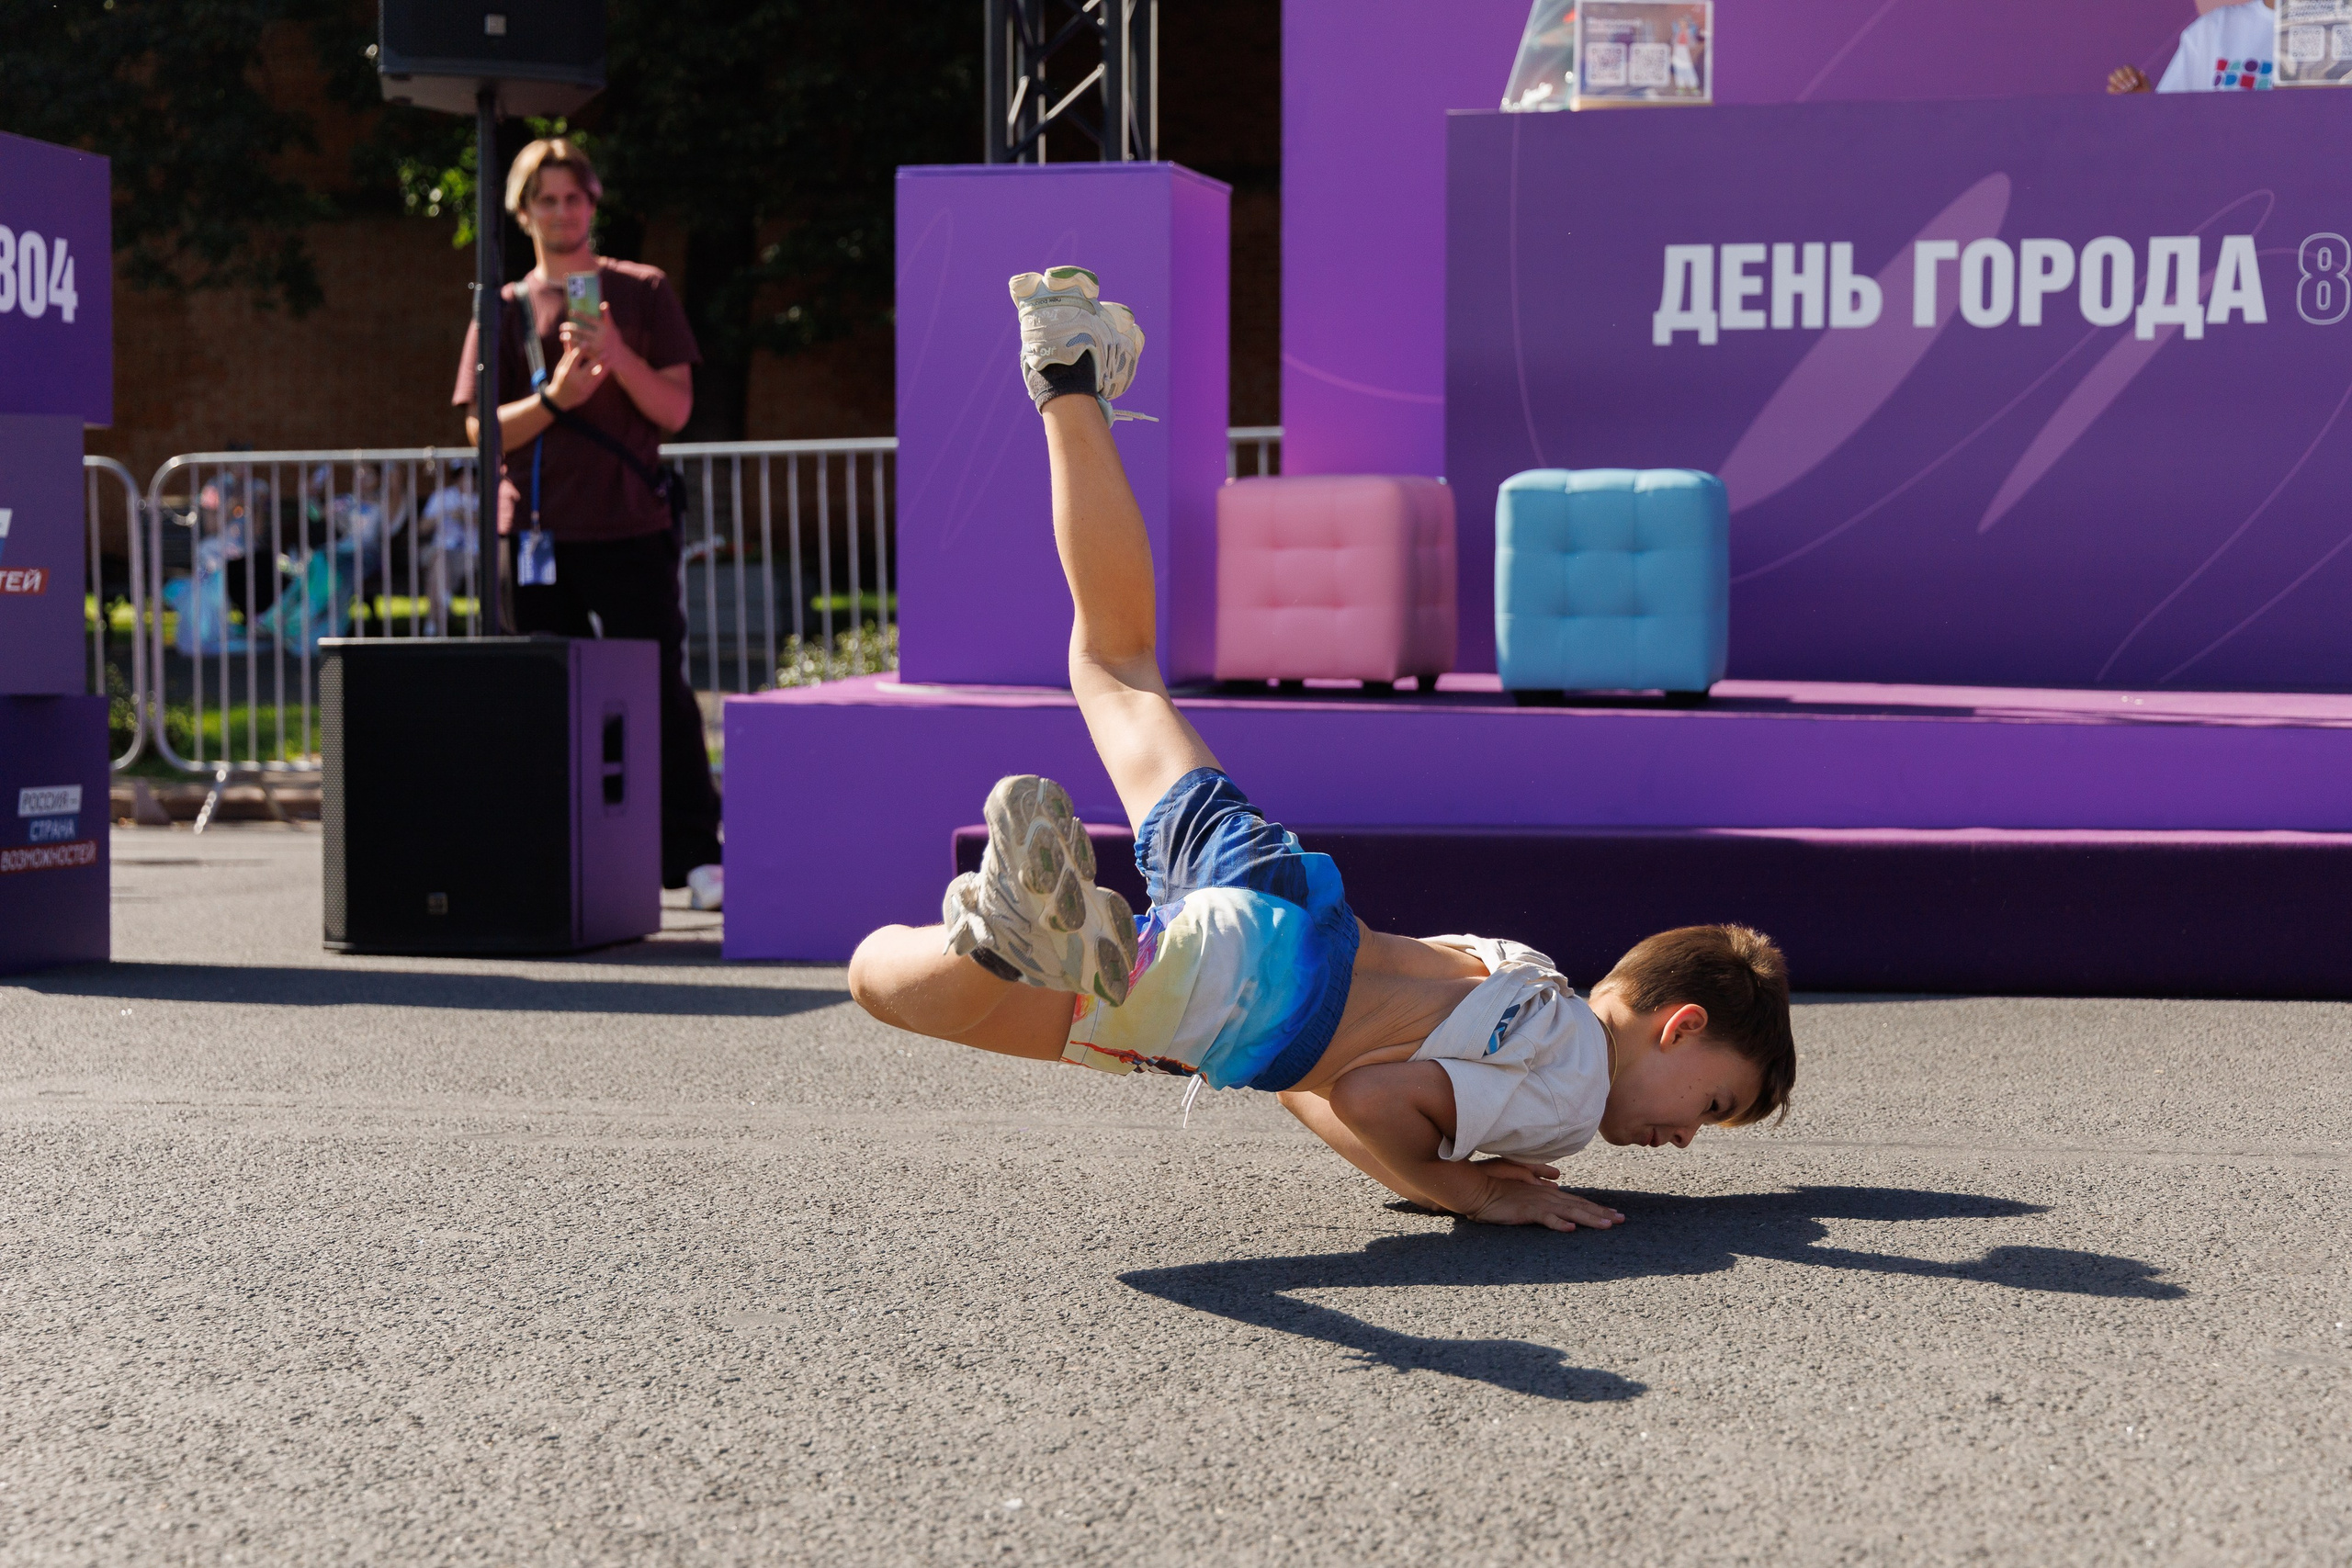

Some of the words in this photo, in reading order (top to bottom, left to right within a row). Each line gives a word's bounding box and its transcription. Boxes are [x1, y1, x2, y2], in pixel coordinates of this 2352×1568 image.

[1653, 241, 1883, 345] ДЕНЬ
[1913, 235, 2268, 340] ГОРОДА
[2296, 231, 2352, 325] 8
[29, 818, 76, 841] СТРАНА
[1, 840, 96, 872] ВОЗМОЖНОСТЕЙ
